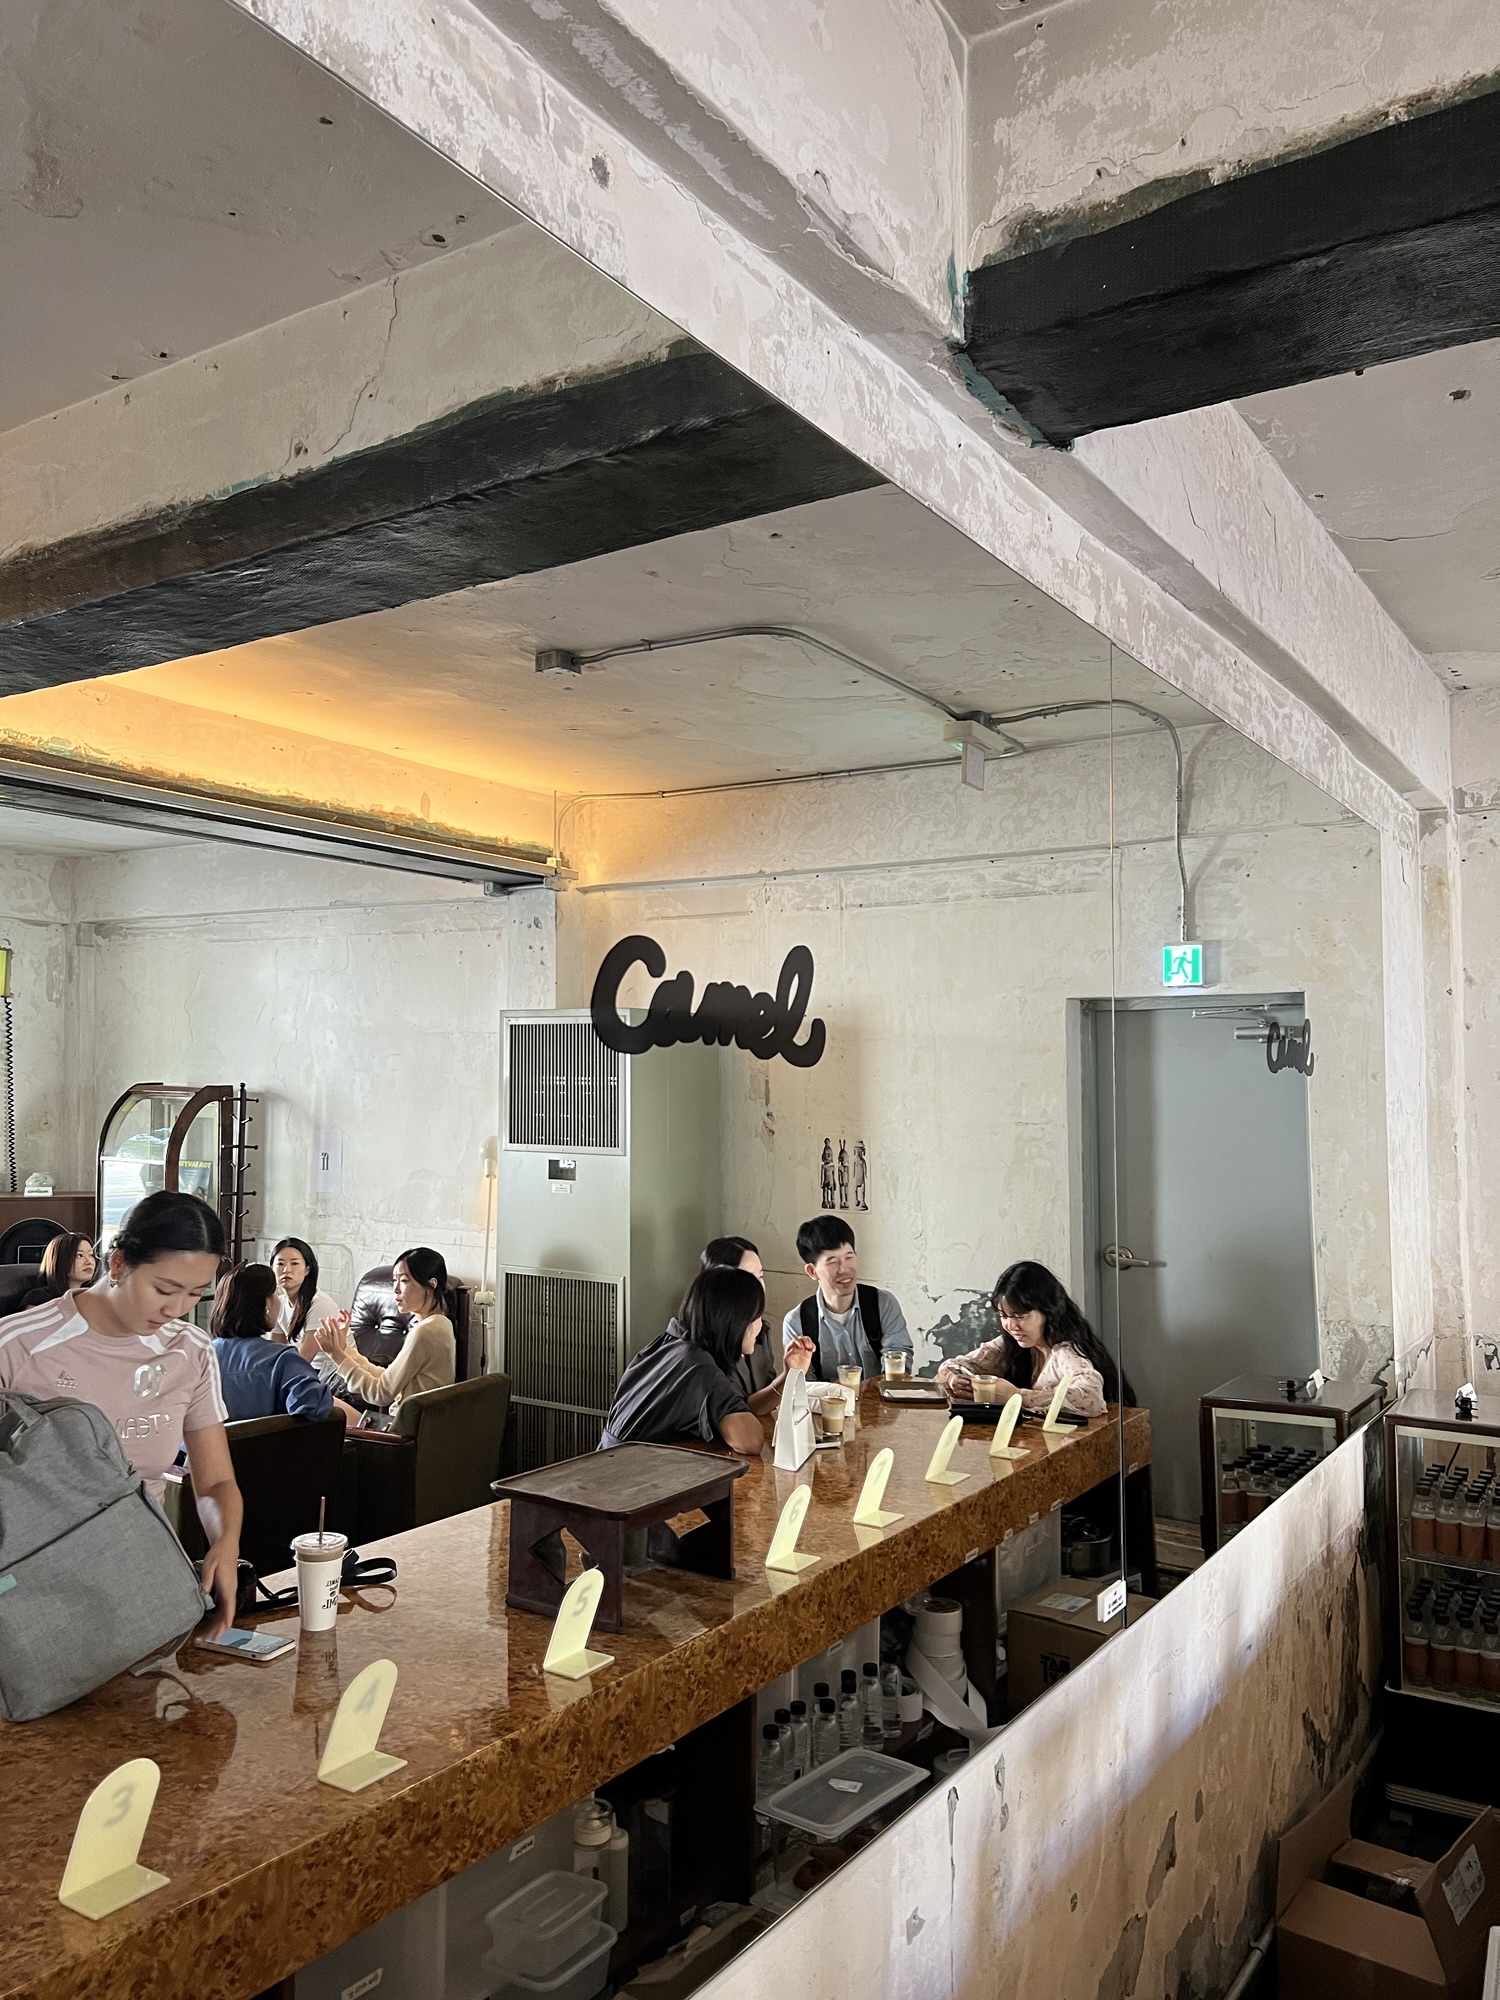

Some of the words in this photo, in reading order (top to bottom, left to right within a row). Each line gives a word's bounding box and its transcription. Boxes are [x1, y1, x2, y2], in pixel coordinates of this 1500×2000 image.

[591, 935, 826, 1067] Camel
[873, 1458, 888, 1485] 7
[788, 1497, 803, 1524] 6
[571, 1584, 592, 1617] 5
[353, 1677, 382, 1715] 4
[103, 1783, 135, 1828] 3
